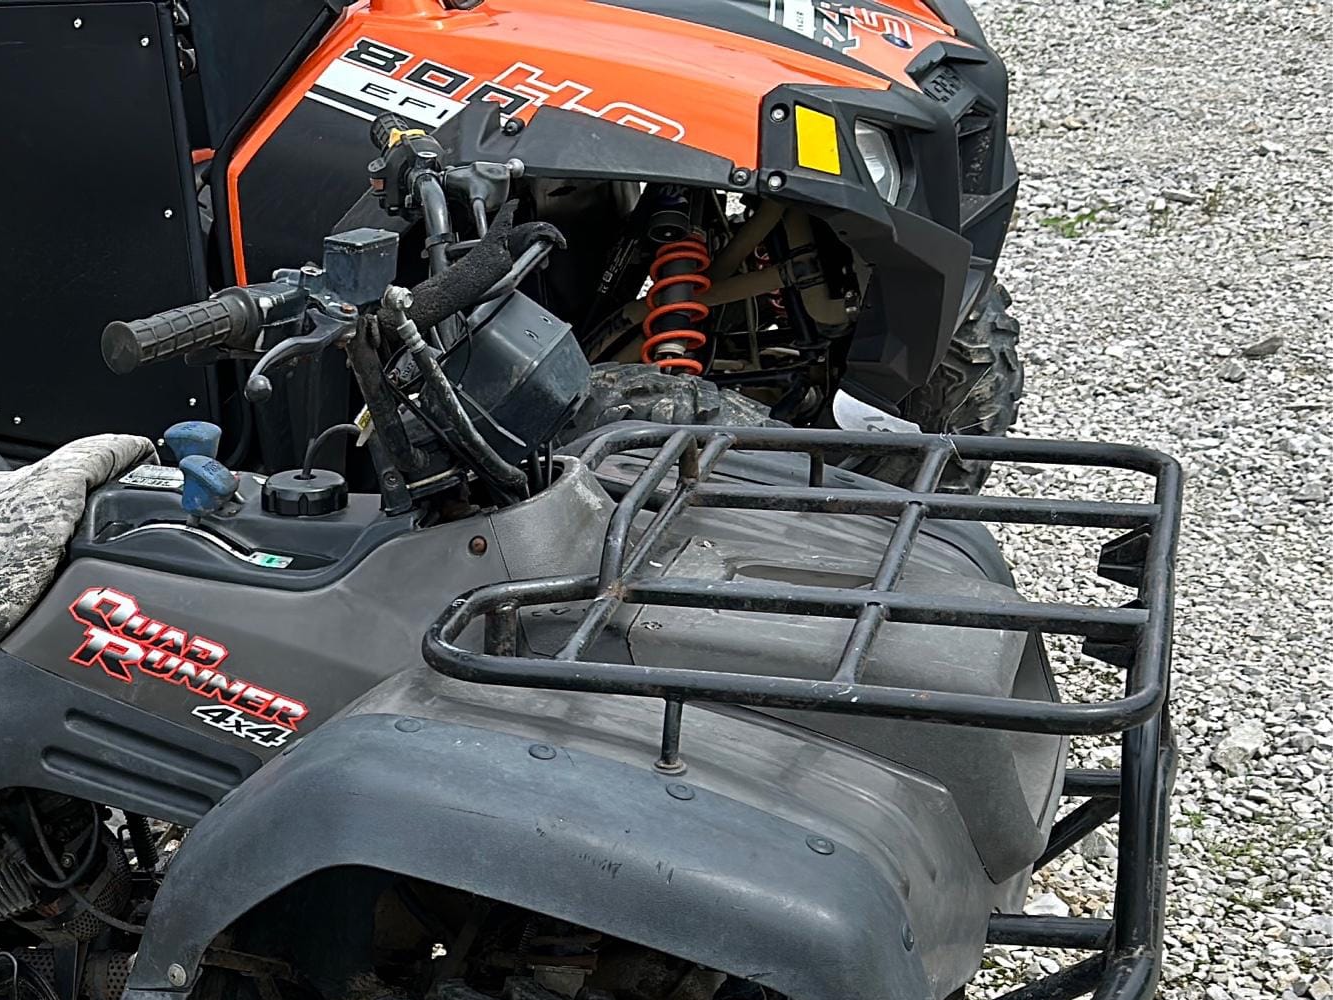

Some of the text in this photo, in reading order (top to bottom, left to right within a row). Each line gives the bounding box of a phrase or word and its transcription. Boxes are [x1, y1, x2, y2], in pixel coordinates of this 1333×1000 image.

[339, 36, 534, 124] 800
[359, 81, 449, 121] EFI
[68, 586, 229, 668] QUAD
[68, 625, 310, 731] RUNNER
[191, 703, 294, 748] 4x4
